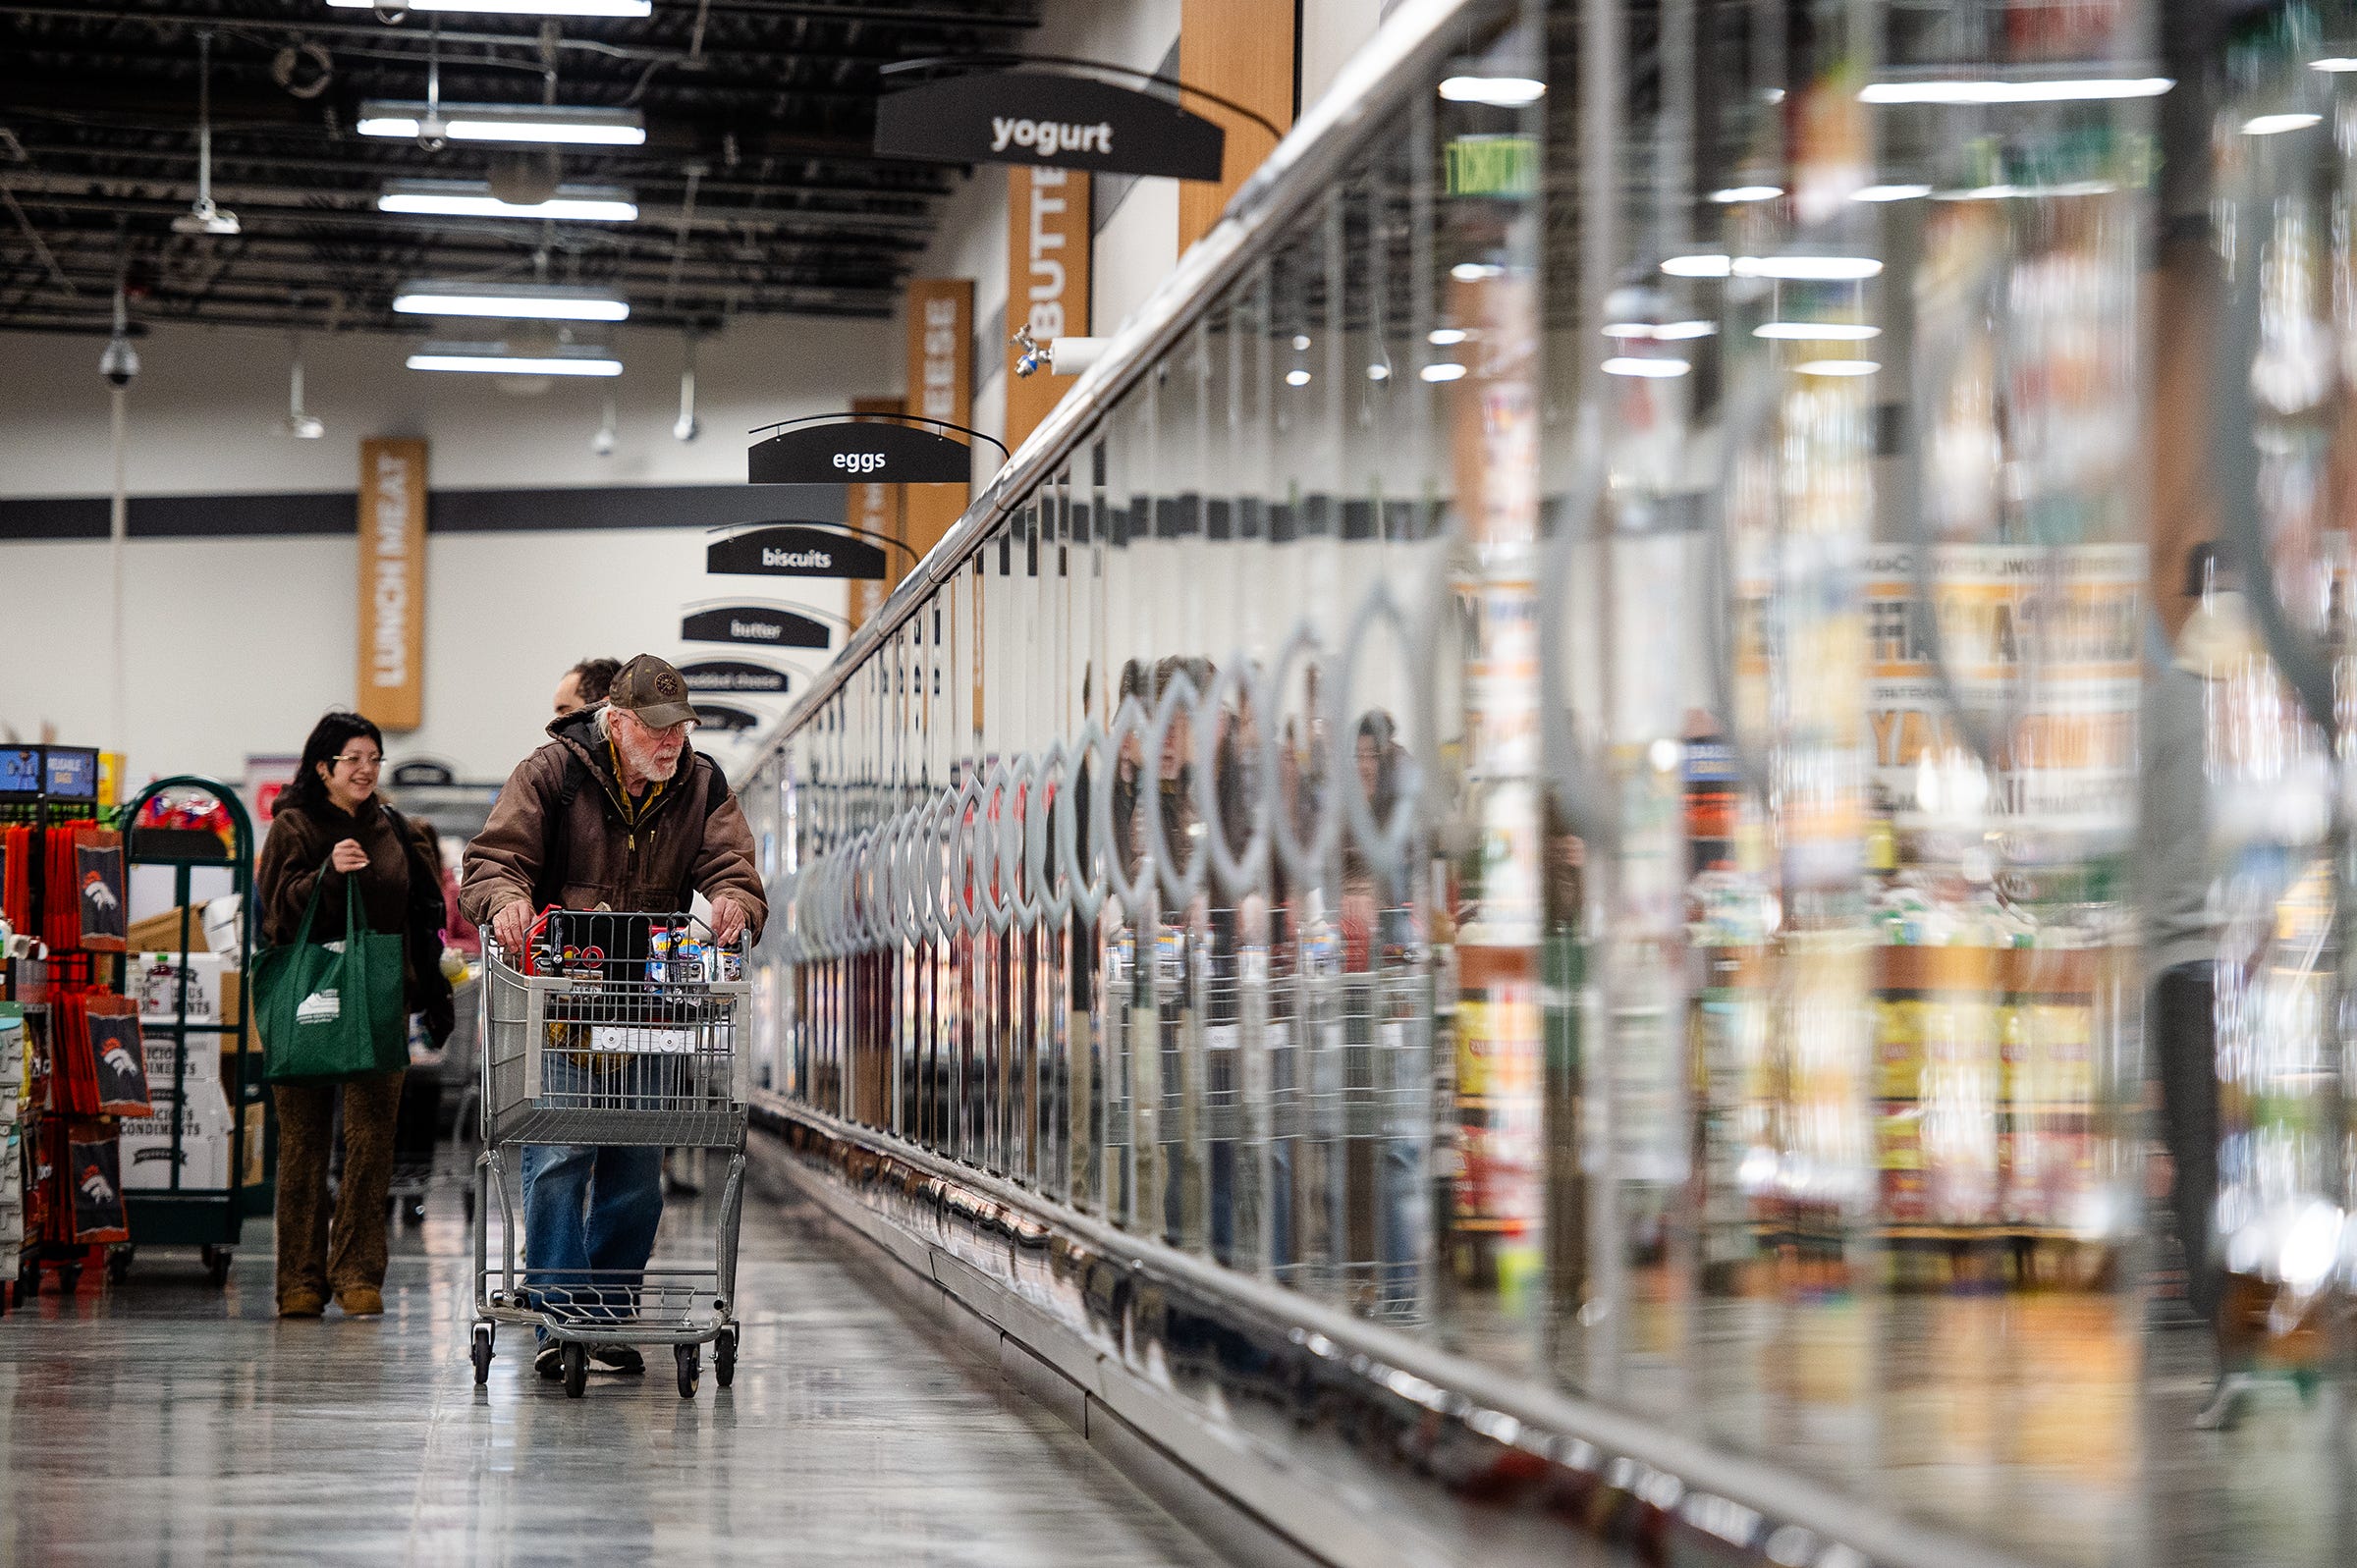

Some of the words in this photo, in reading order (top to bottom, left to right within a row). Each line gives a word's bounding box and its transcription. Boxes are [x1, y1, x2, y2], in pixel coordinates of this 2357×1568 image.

[990, 116, 1113, 157] yogurt
[1028, 165, 1068, 340] BUTTE
[833, 453, 886, 472] eggs
[374, 454, 409, 557] MEAT
[762, 547, 832, 568] biscuits
[373, 560, 407, 687] LUNCH
[730, 619, 783, 640] butter
[119, 1121, 200, 1136] CONDIMTS
